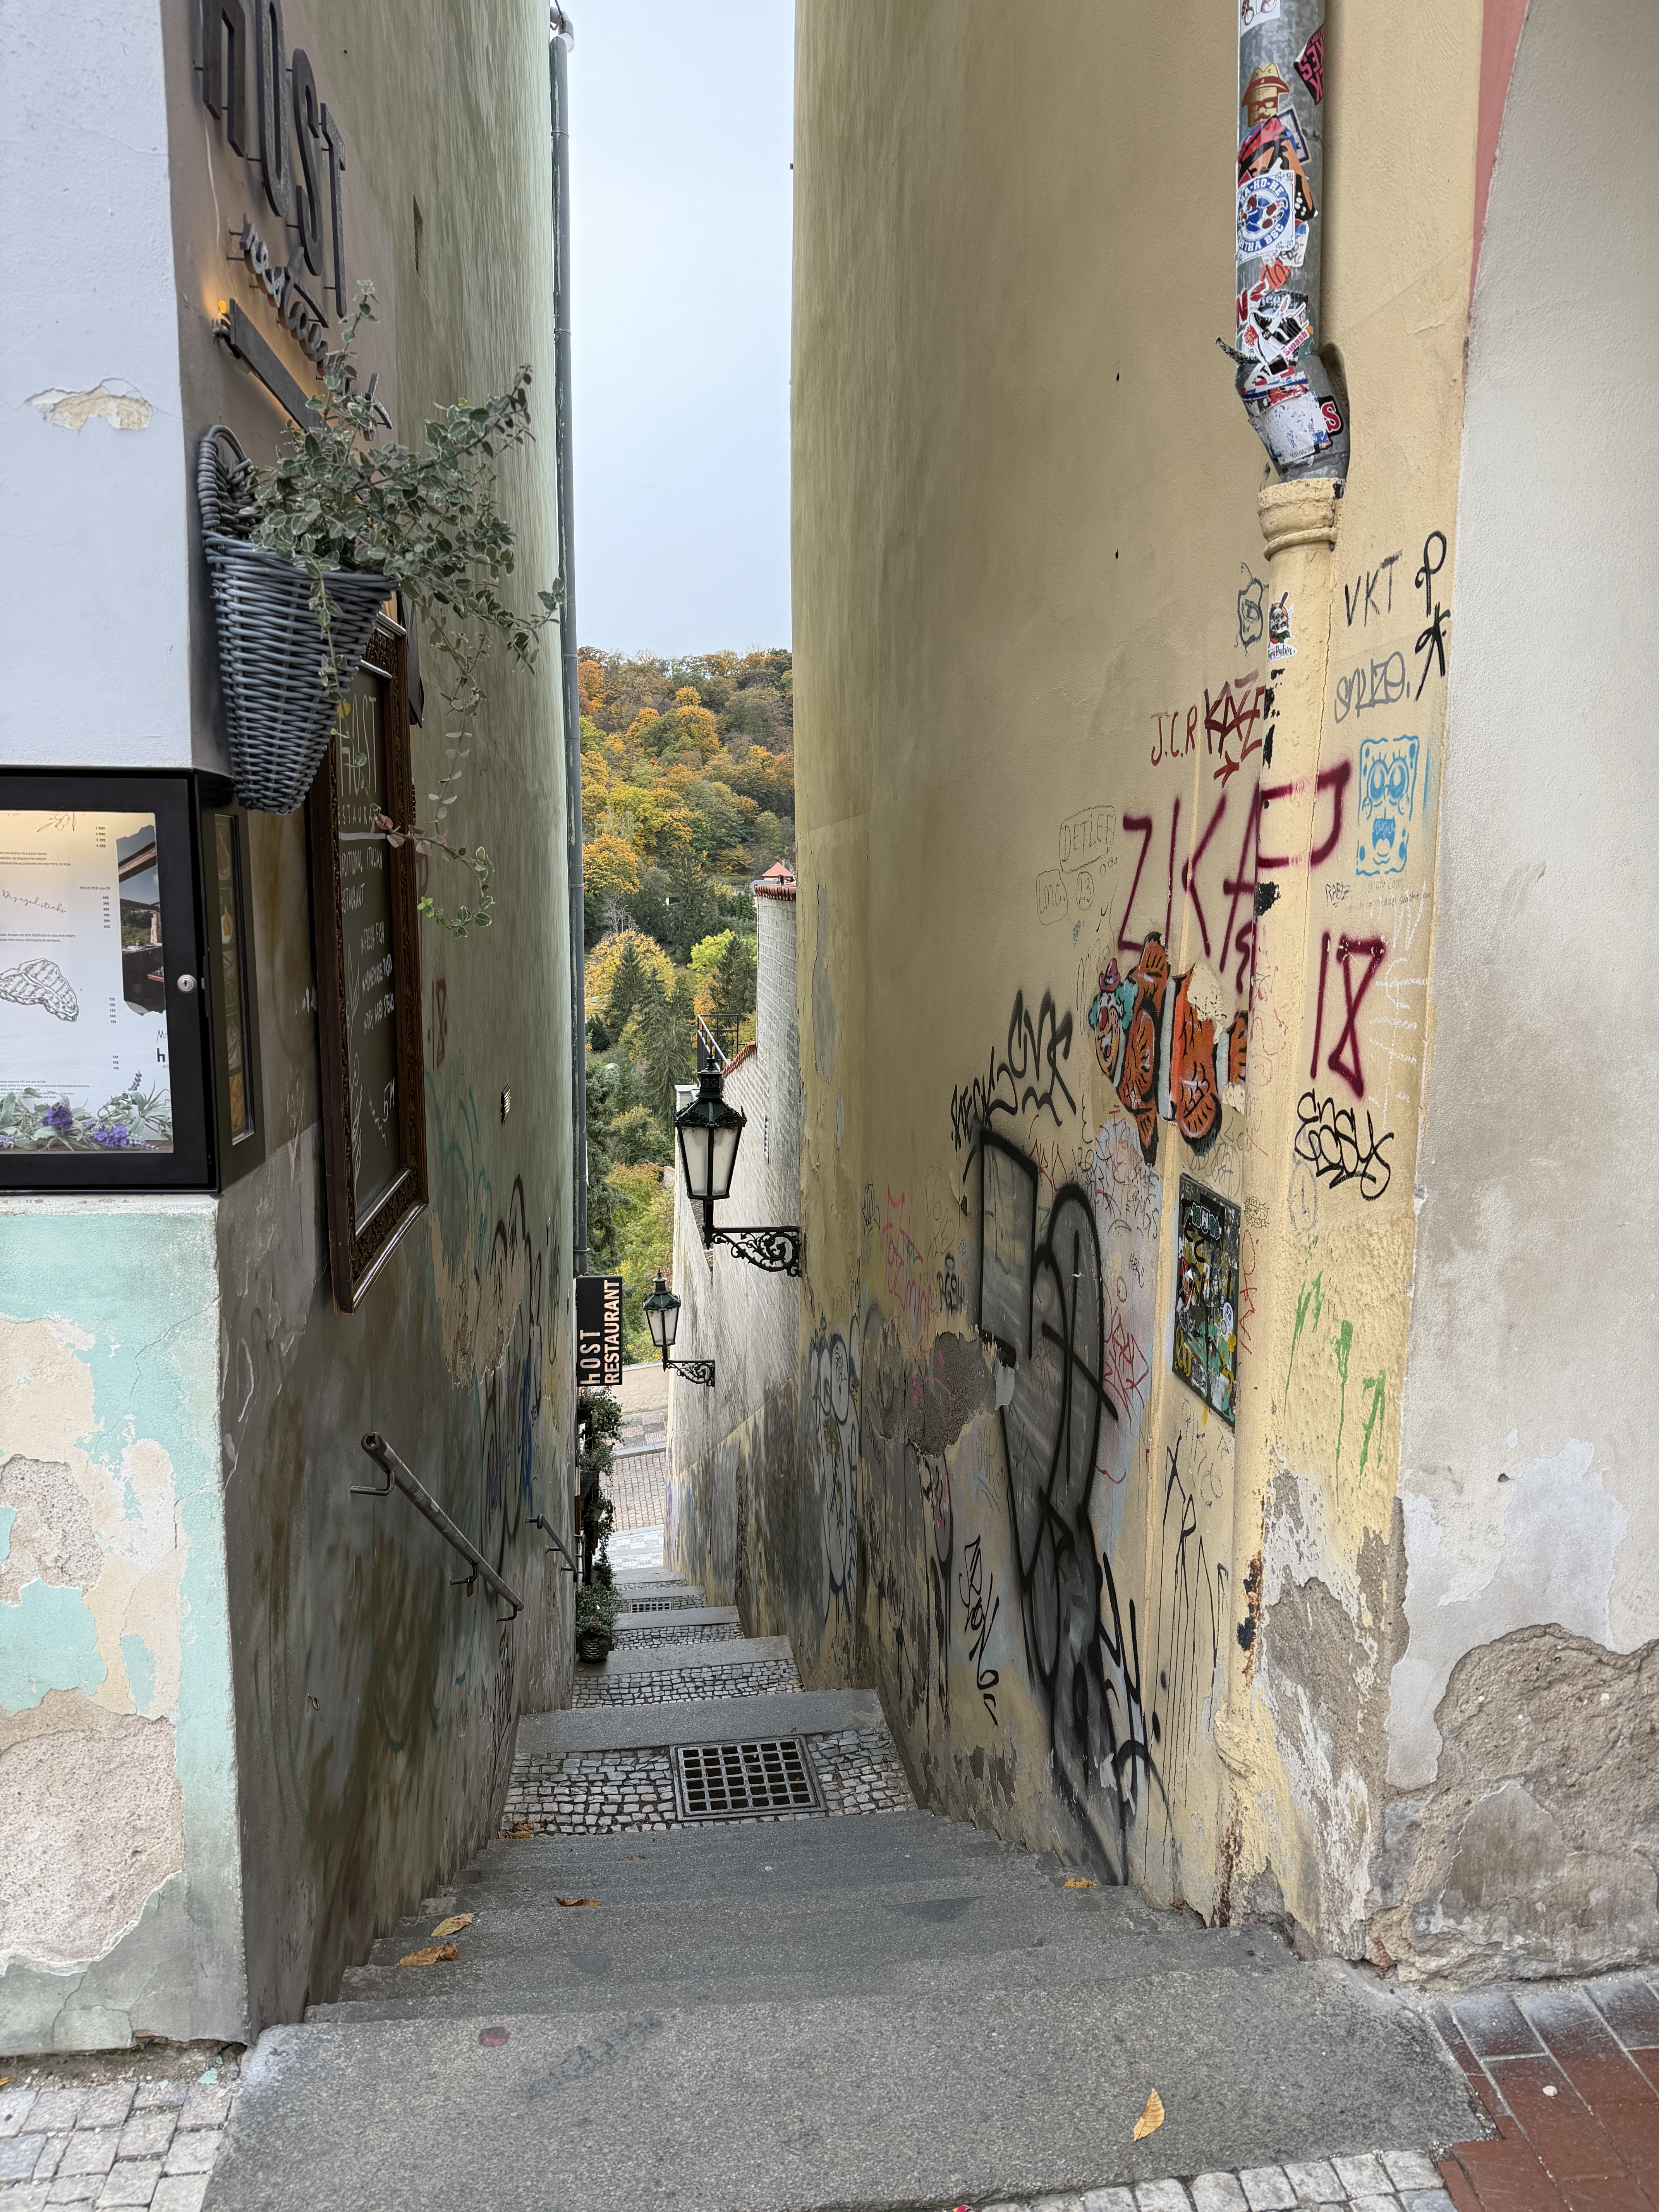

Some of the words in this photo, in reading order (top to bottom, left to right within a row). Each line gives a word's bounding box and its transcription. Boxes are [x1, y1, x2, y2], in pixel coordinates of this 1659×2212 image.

[1264, 223, 1284, 245] BSC
[1283, 331, 1308, 356] Smash
[604, 1280, 620, 1384] RESTAURANT
